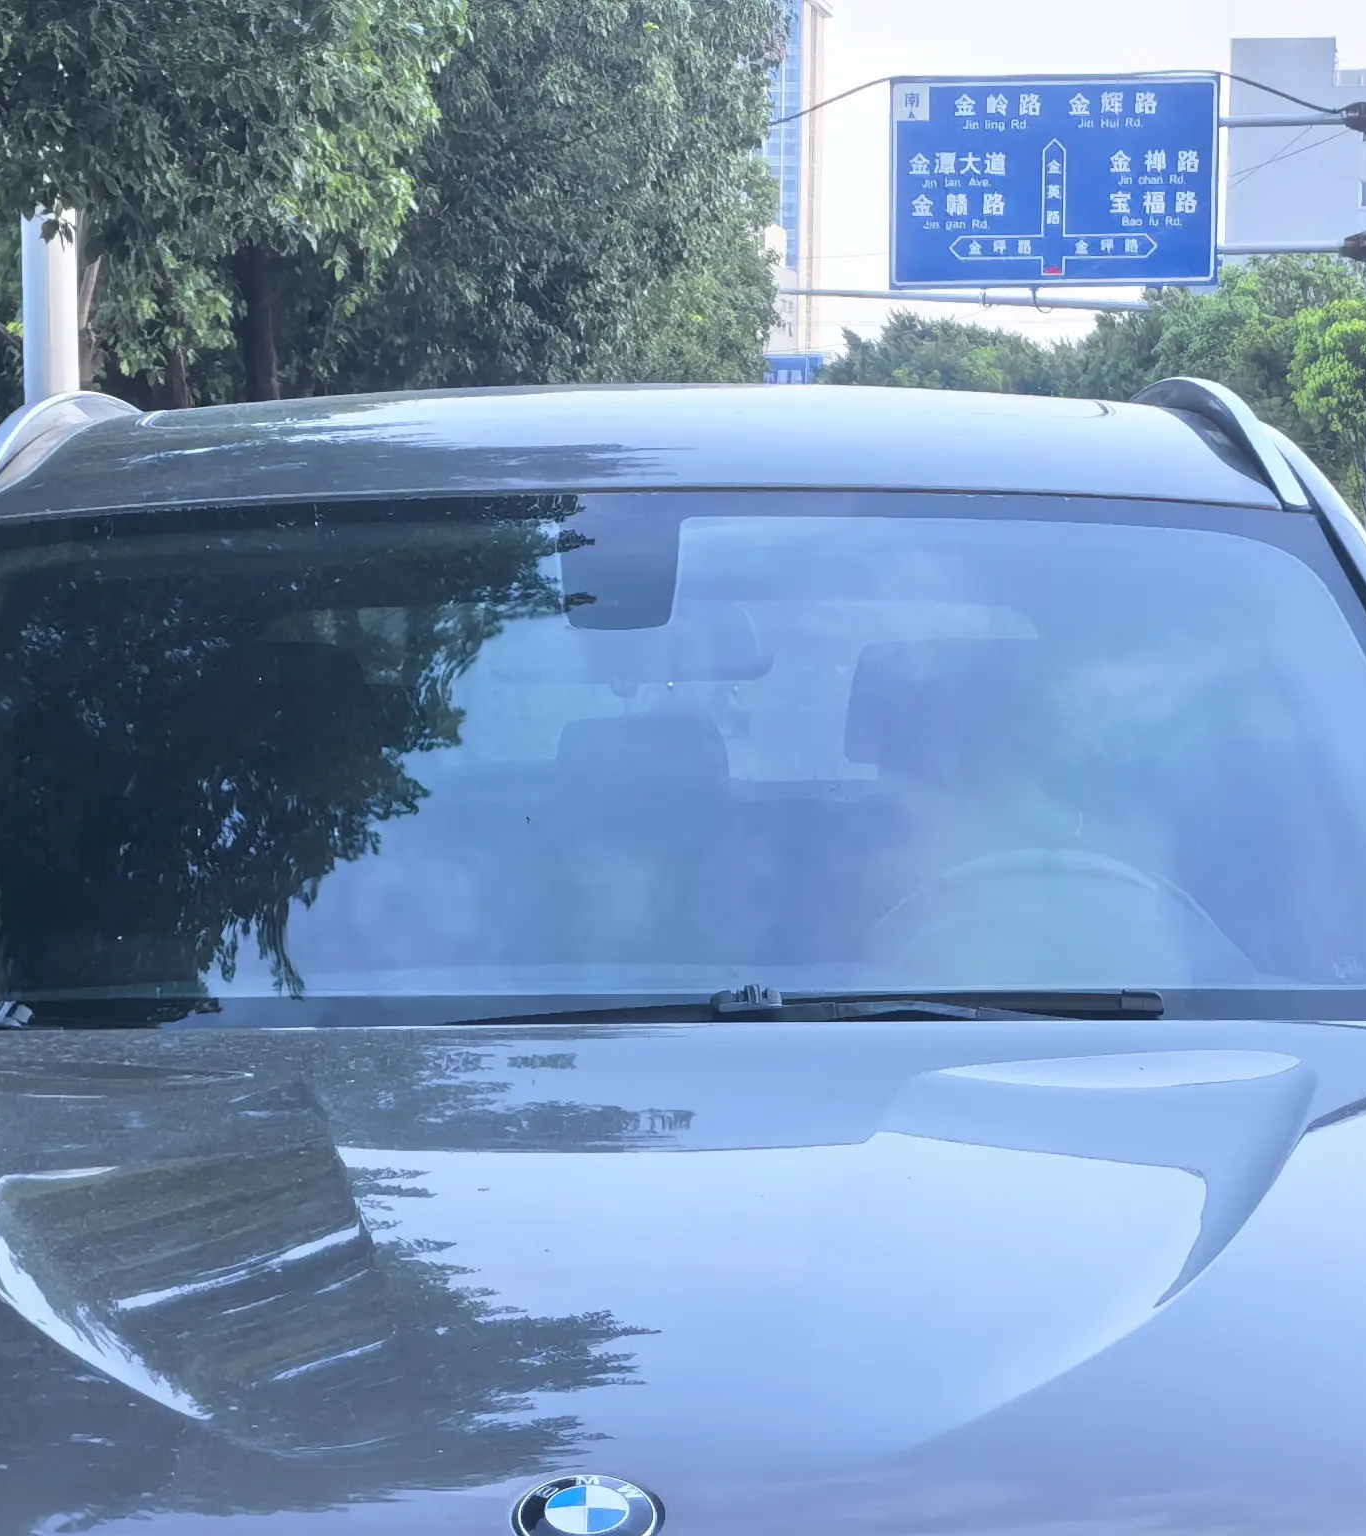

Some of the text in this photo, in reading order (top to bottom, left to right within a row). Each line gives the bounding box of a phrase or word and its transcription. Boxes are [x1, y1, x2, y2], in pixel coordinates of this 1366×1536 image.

[904, 92, 920, 108] 南
[954, 93, 1041, 116] 金岭路
[1068, 91, 1157, 116] 金辉路
[962, 119, 979, 130] Jin
[535, 1475, 644, 1499] BMW
